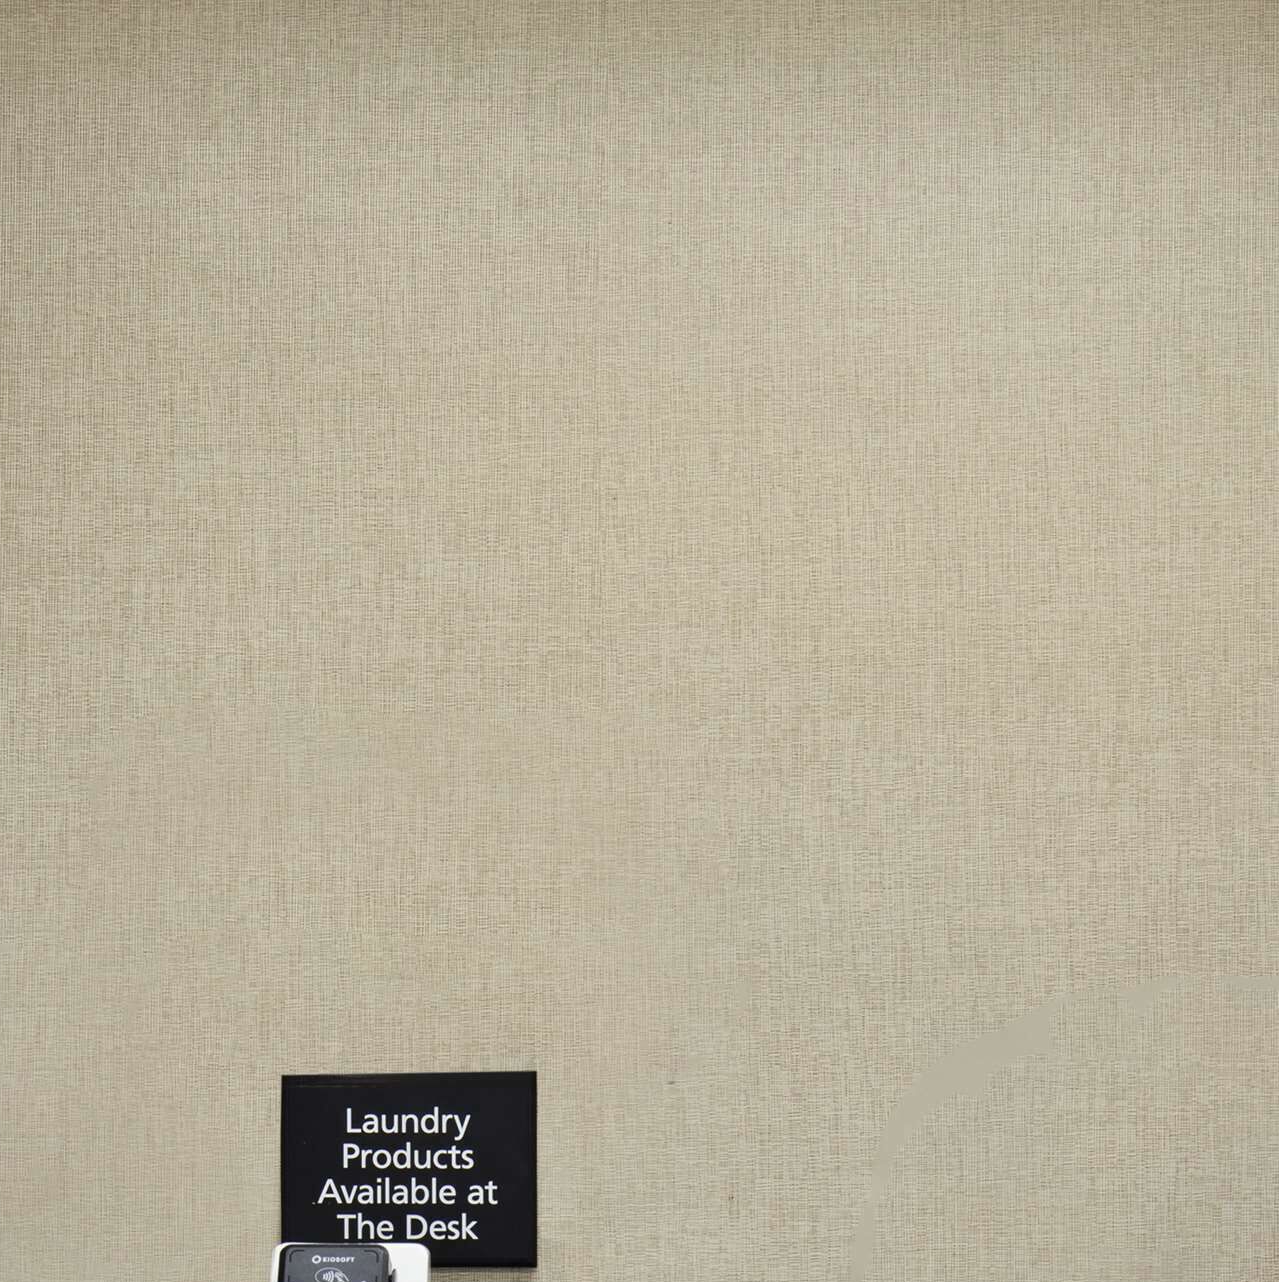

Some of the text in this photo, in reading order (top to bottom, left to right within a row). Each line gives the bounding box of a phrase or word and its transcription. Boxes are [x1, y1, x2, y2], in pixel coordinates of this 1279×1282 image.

[346, 1106, 471, 1141] Laundry
[342, 1142, 474, 1169] Products
[317, 1177, 498, 1205] Available at
[336, 1212, 479, 1240] The Desk
